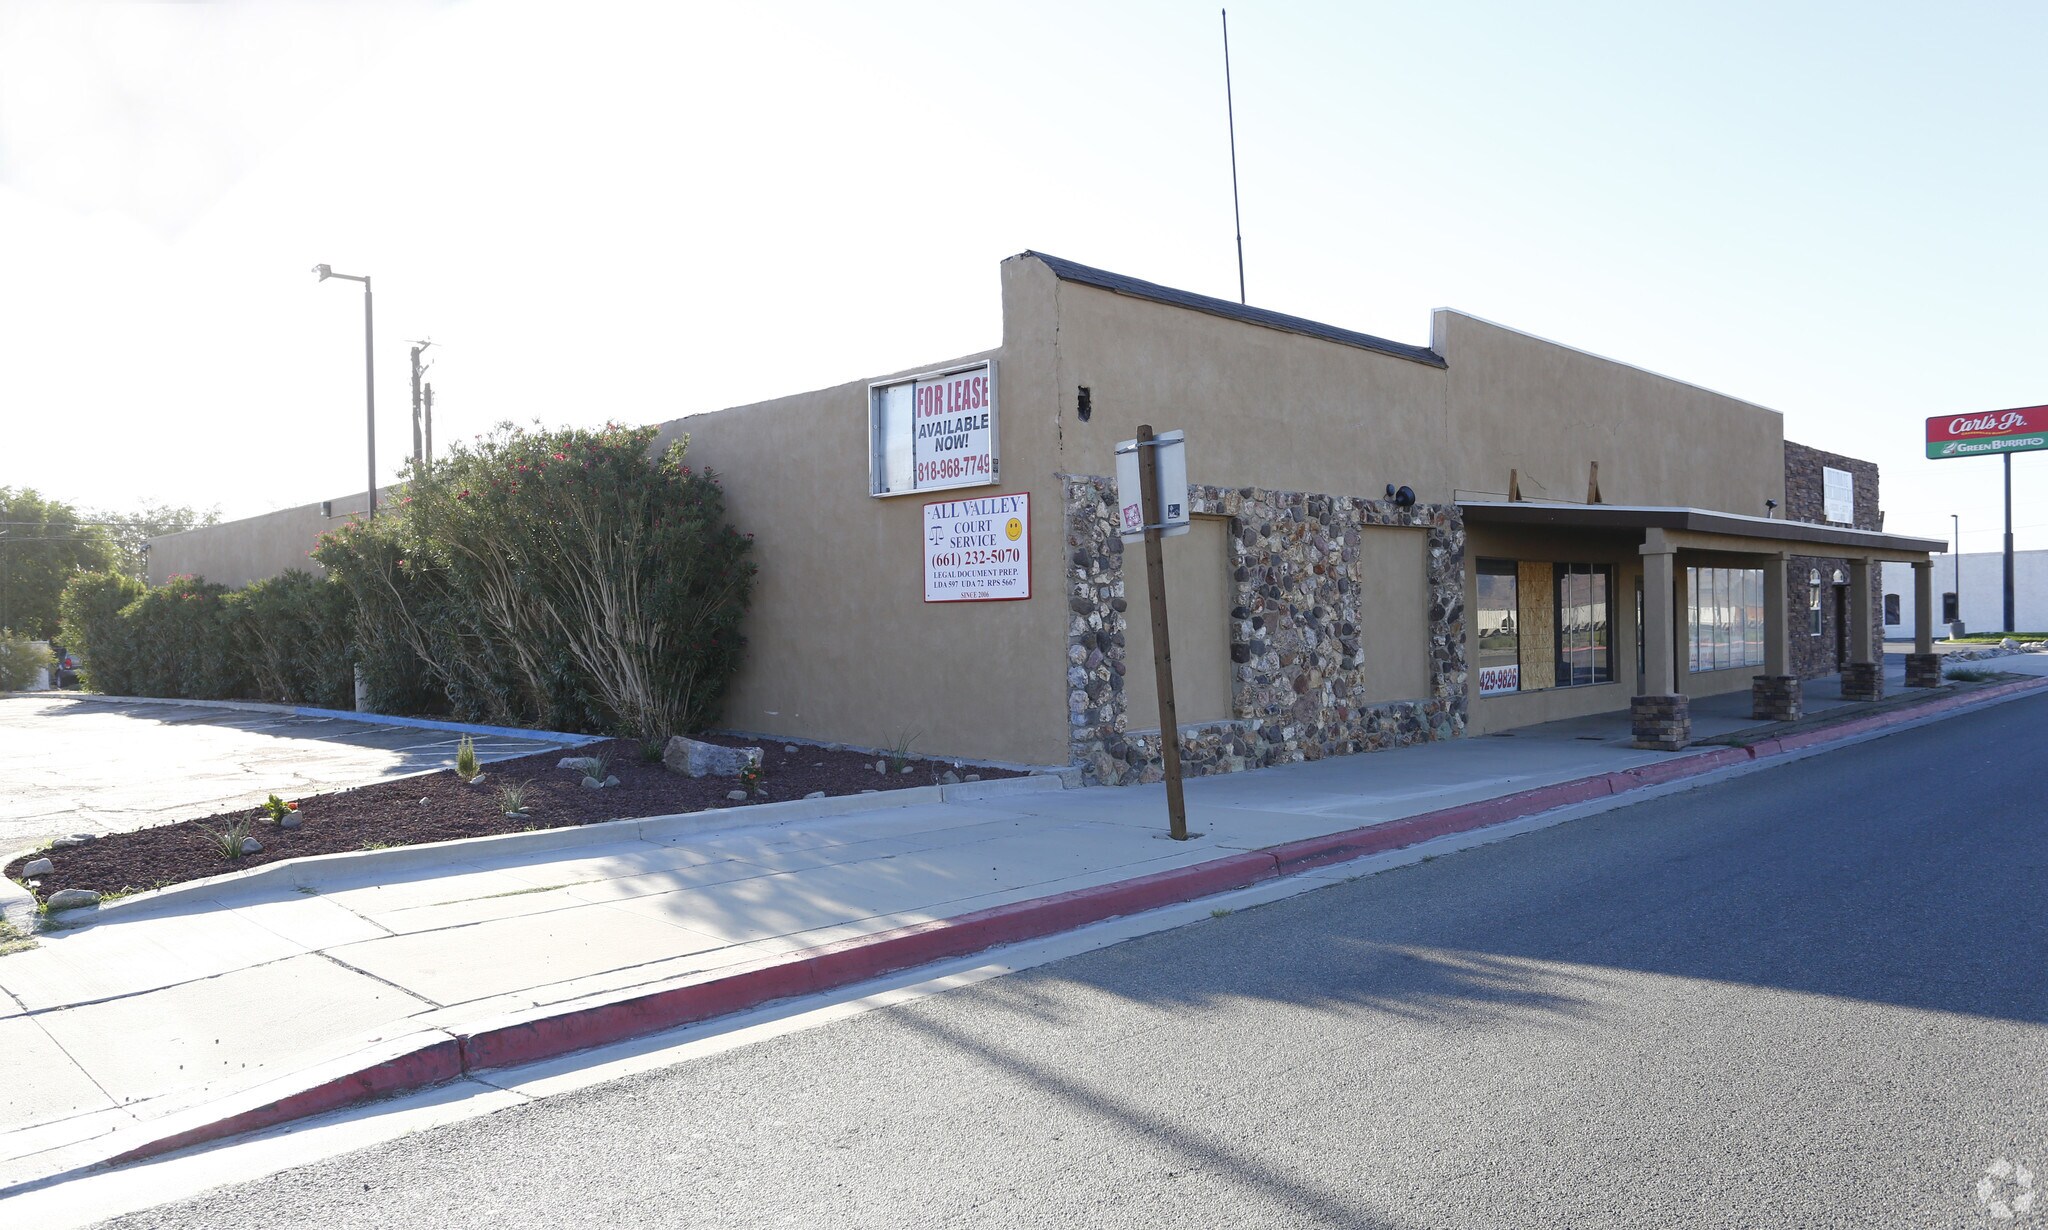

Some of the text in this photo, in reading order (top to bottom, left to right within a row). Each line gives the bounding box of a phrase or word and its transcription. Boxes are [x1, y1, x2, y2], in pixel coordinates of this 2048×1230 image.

[917, 376, 988, 418] FOR LEASE
[918, 413, 988, 439] AVAILABLE
[1948, 412, 2028, 434] Carl's Jr.
[935, 433, 969, 452] NOW!
[918, 453, 990, 482] 818-968-7749
[932, 496, 1021, 520] ALL VALLEY
[954, 520, 992, 534] COURT
[950, 534, 997, 549] SERVICE
[932, 548, 1020, 570] (661) 232-5070
[934, 568, 1019, 579] LEGAL DOCUMENT PREP.
[934, 581, 948, 589] LDA
[961, 580, 976, 588] UDA
[987, 579, 1001, 587] RPS
[1480, 668, 1517, 691] 429-9826
